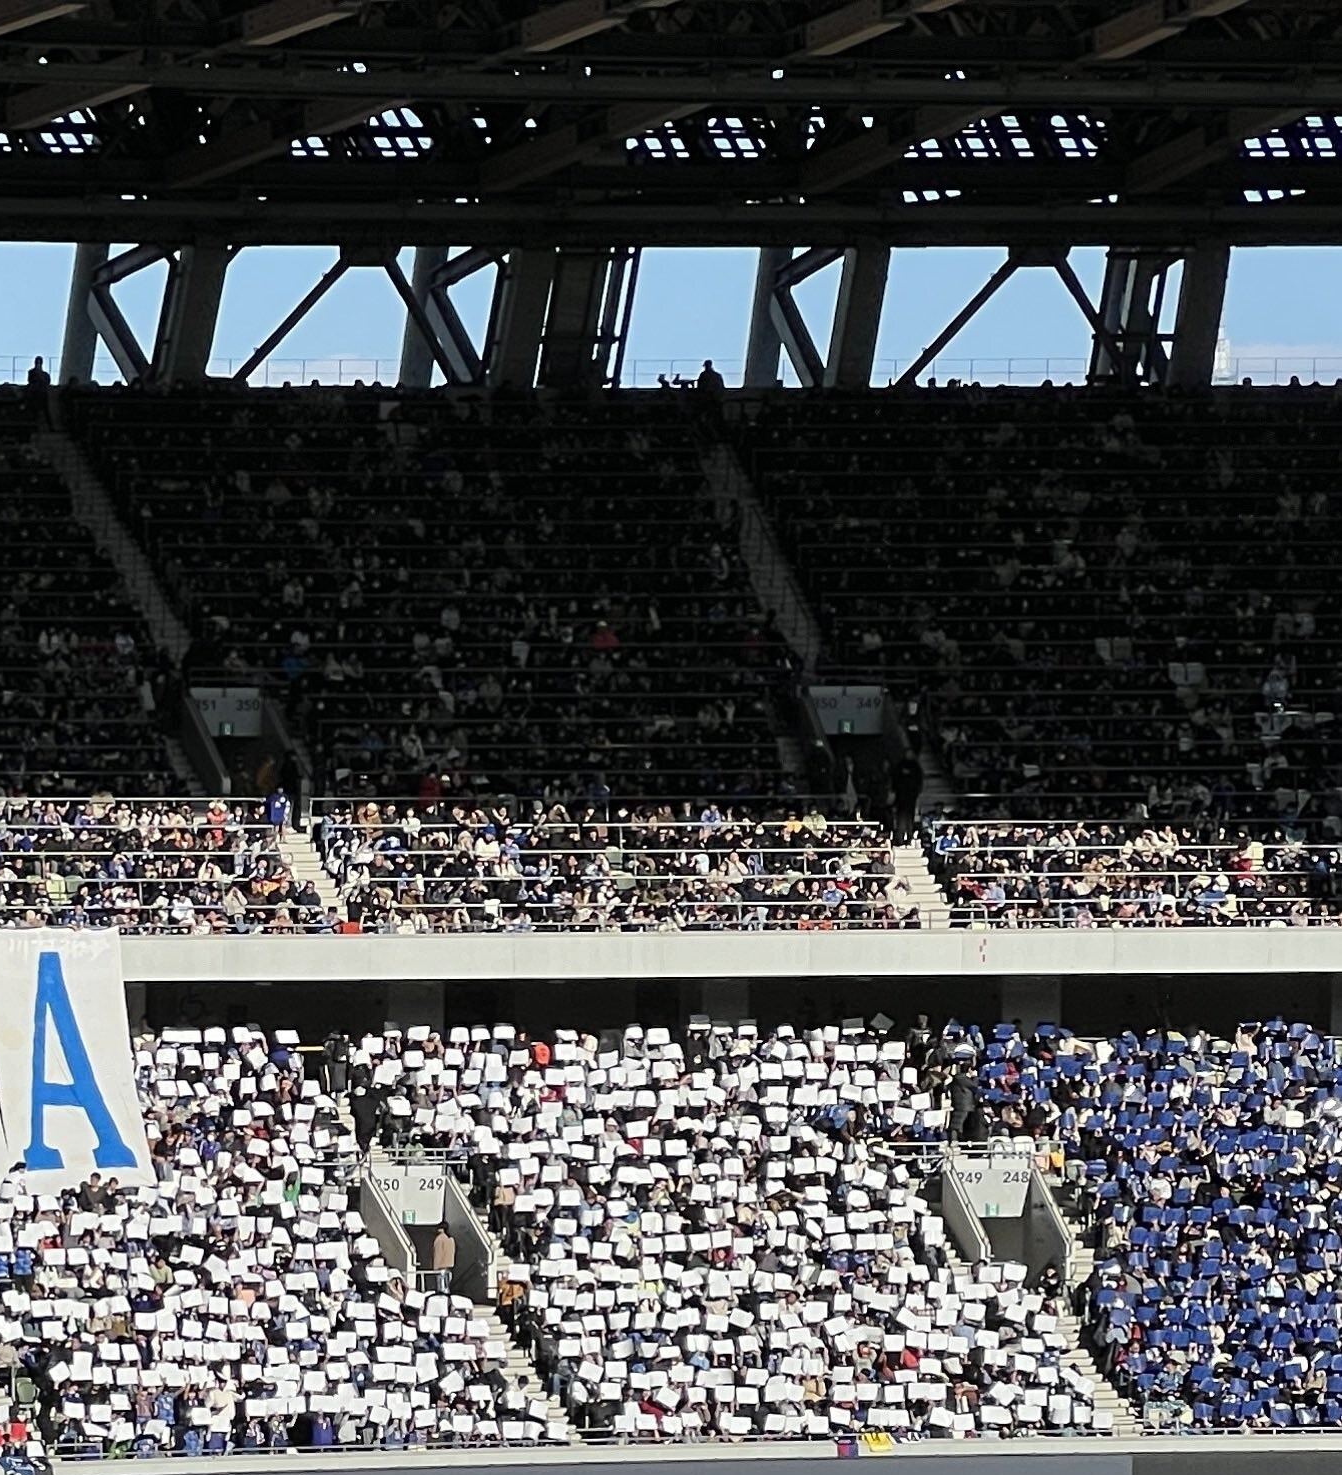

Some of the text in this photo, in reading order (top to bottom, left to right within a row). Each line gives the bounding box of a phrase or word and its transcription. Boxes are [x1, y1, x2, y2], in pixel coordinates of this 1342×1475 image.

[235, 699, 260, 712] 350
[1002, 1171, 1029, 1184] 248
[418, 1178, 444, 1191] 249
